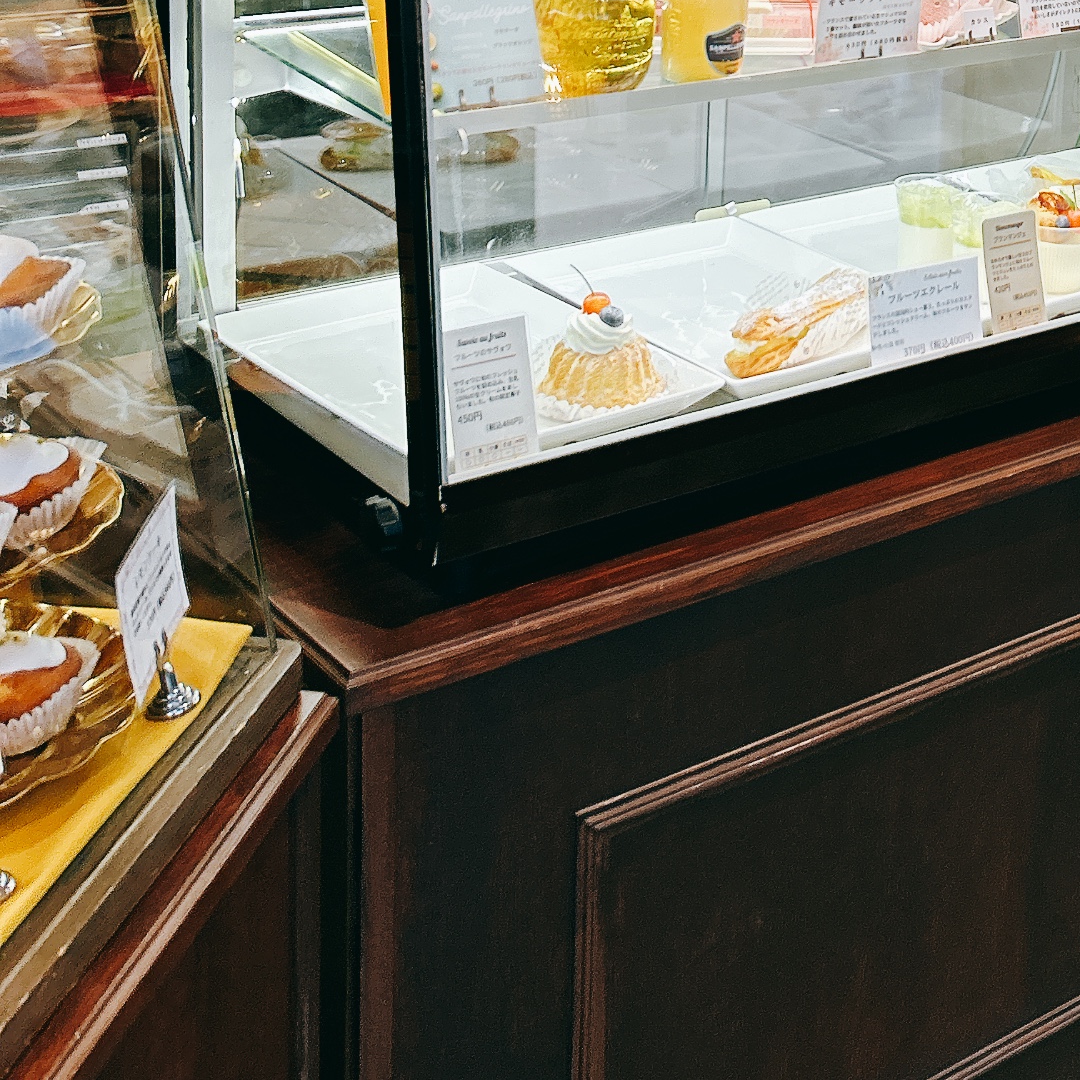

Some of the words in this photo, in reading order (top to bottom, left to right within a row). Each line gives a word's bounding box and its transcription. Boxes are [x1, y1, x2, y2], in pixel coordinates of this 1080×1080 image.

[888, 281, 960, 304] フルーツエクレール
[454, 343, 512, 362] フルーツのサヴォワ
[457, 410, 482, 424] 450円
